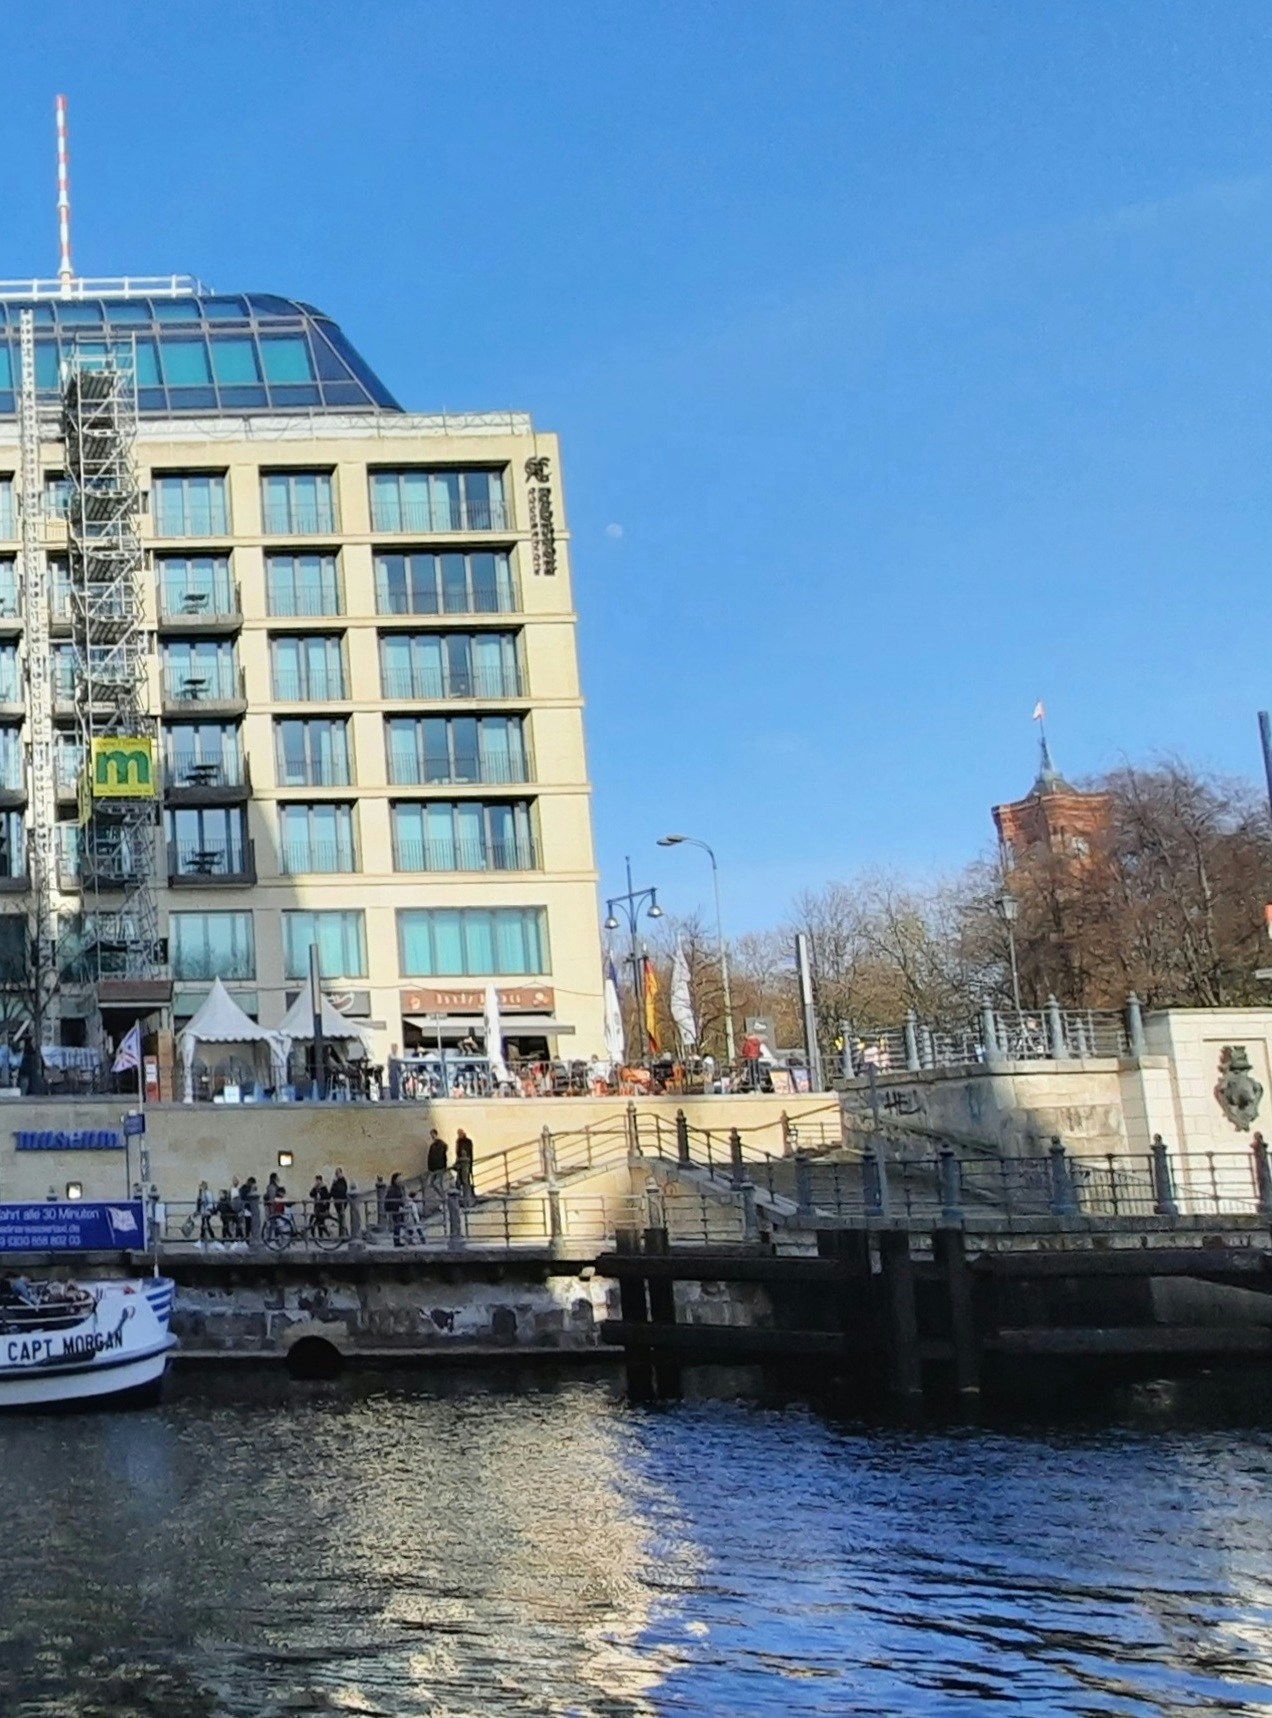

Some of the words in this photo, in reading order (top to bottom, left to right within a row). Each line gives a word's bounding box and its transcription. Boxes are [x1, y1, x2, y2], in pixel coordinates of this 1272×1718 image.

[96, 750, 149, 784] m
[42, 1208, 56, 1220] 30
[59, 1208, 99, 1219] Minuten
[8, 1339, 52, 1361] CAPT
[62, 1328, 122, 1356] MORGAN
